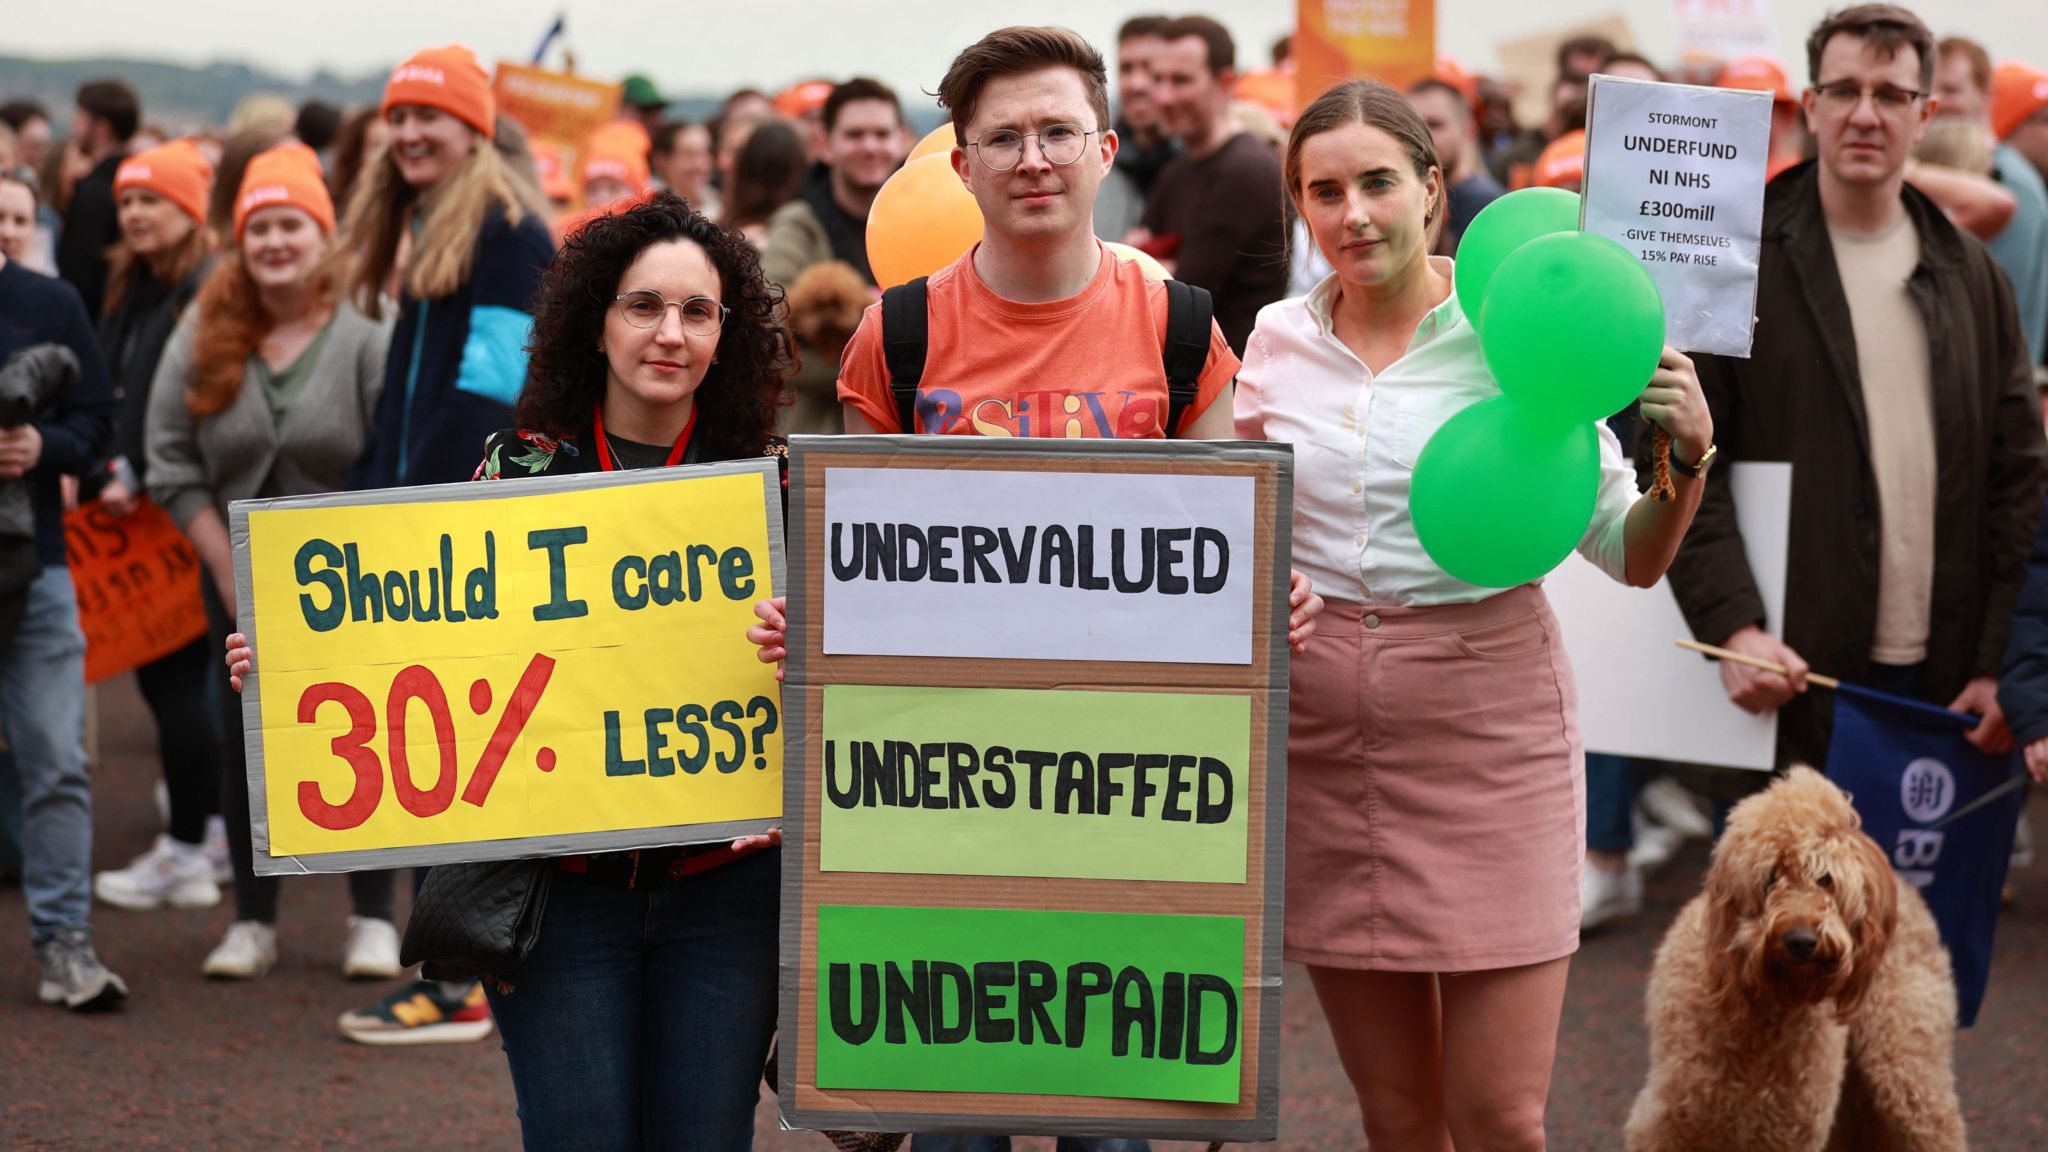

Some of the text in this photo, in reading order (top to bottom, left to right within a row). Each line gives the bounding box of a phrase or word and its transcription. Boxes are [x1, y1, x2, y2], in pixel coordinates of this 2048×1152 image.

[1648, 112, 1718, 129] STORMONT
[1623, 135, 1737, 160] UNDERFUND
[1649, 169, 1711, 189] NI NHS
[1639, 200, 1715, 222] £300mill
[1659, 231, 1731, 249] THEMSELVES
[1641, 250, 1717, 267] 15% PAY RISE
[831, 523, 1229, 594] UNDERVALUED
[294, 531, 500, 632] Should
[528, 526, 589, 621] I
[612, 543, 756, 611] care
[297, 653, 779, 831] 30% LESS?
[825, 740, 1233, 825] UNDERSTAFFED
[829, 960, 1238, 1066] UNDERPAID
